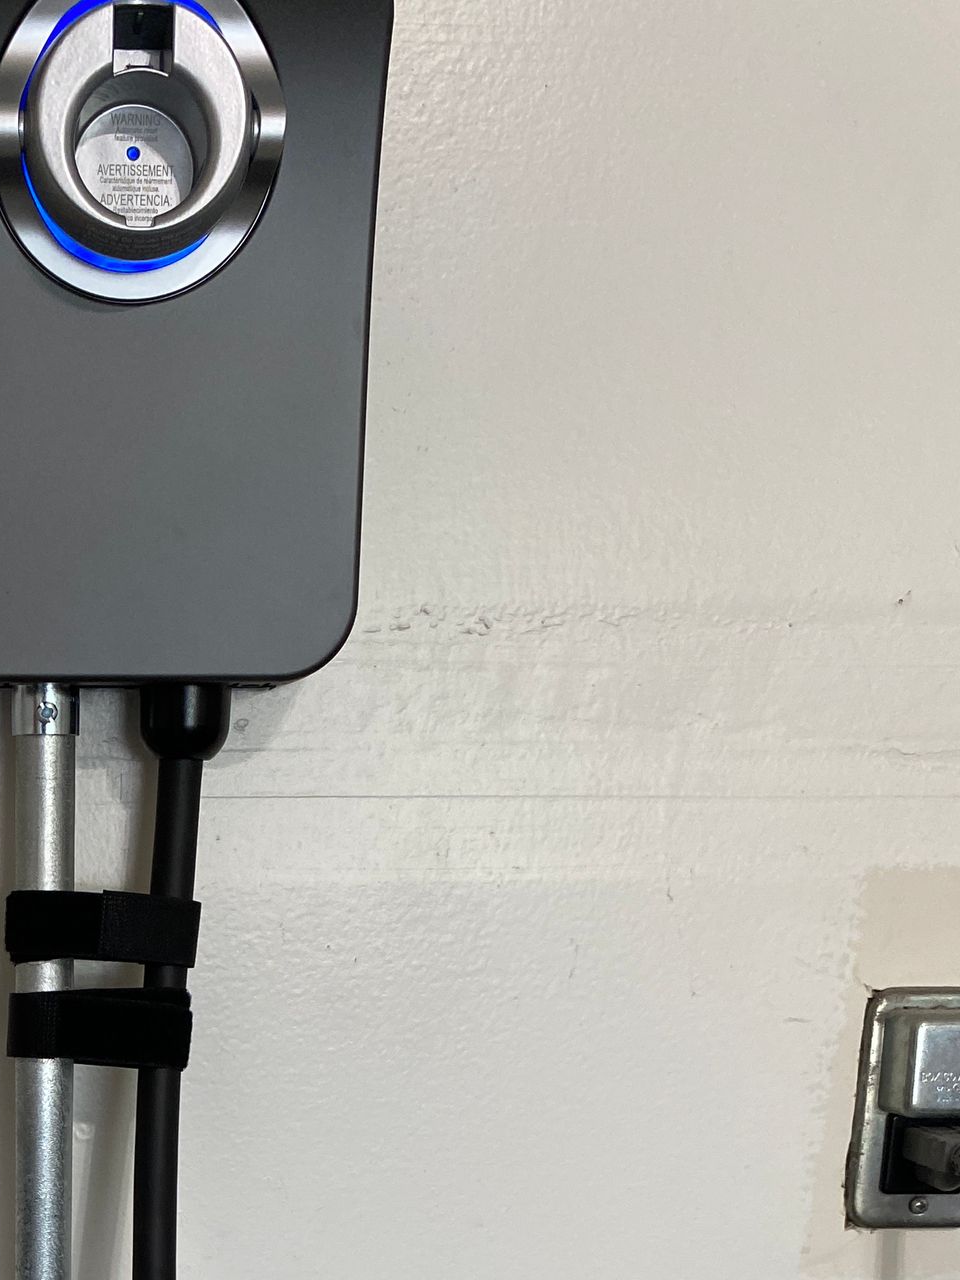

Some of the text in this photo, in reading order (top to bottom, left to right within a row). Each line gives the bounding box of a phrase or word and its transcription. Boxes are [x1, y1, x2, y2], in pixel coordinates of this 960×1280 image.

[111, 113, 161, 126] WARNING
[97, 164, 174, 177] AVERTISSEMENT
[100, 194, 173, 206] ADVERTENCIA:
